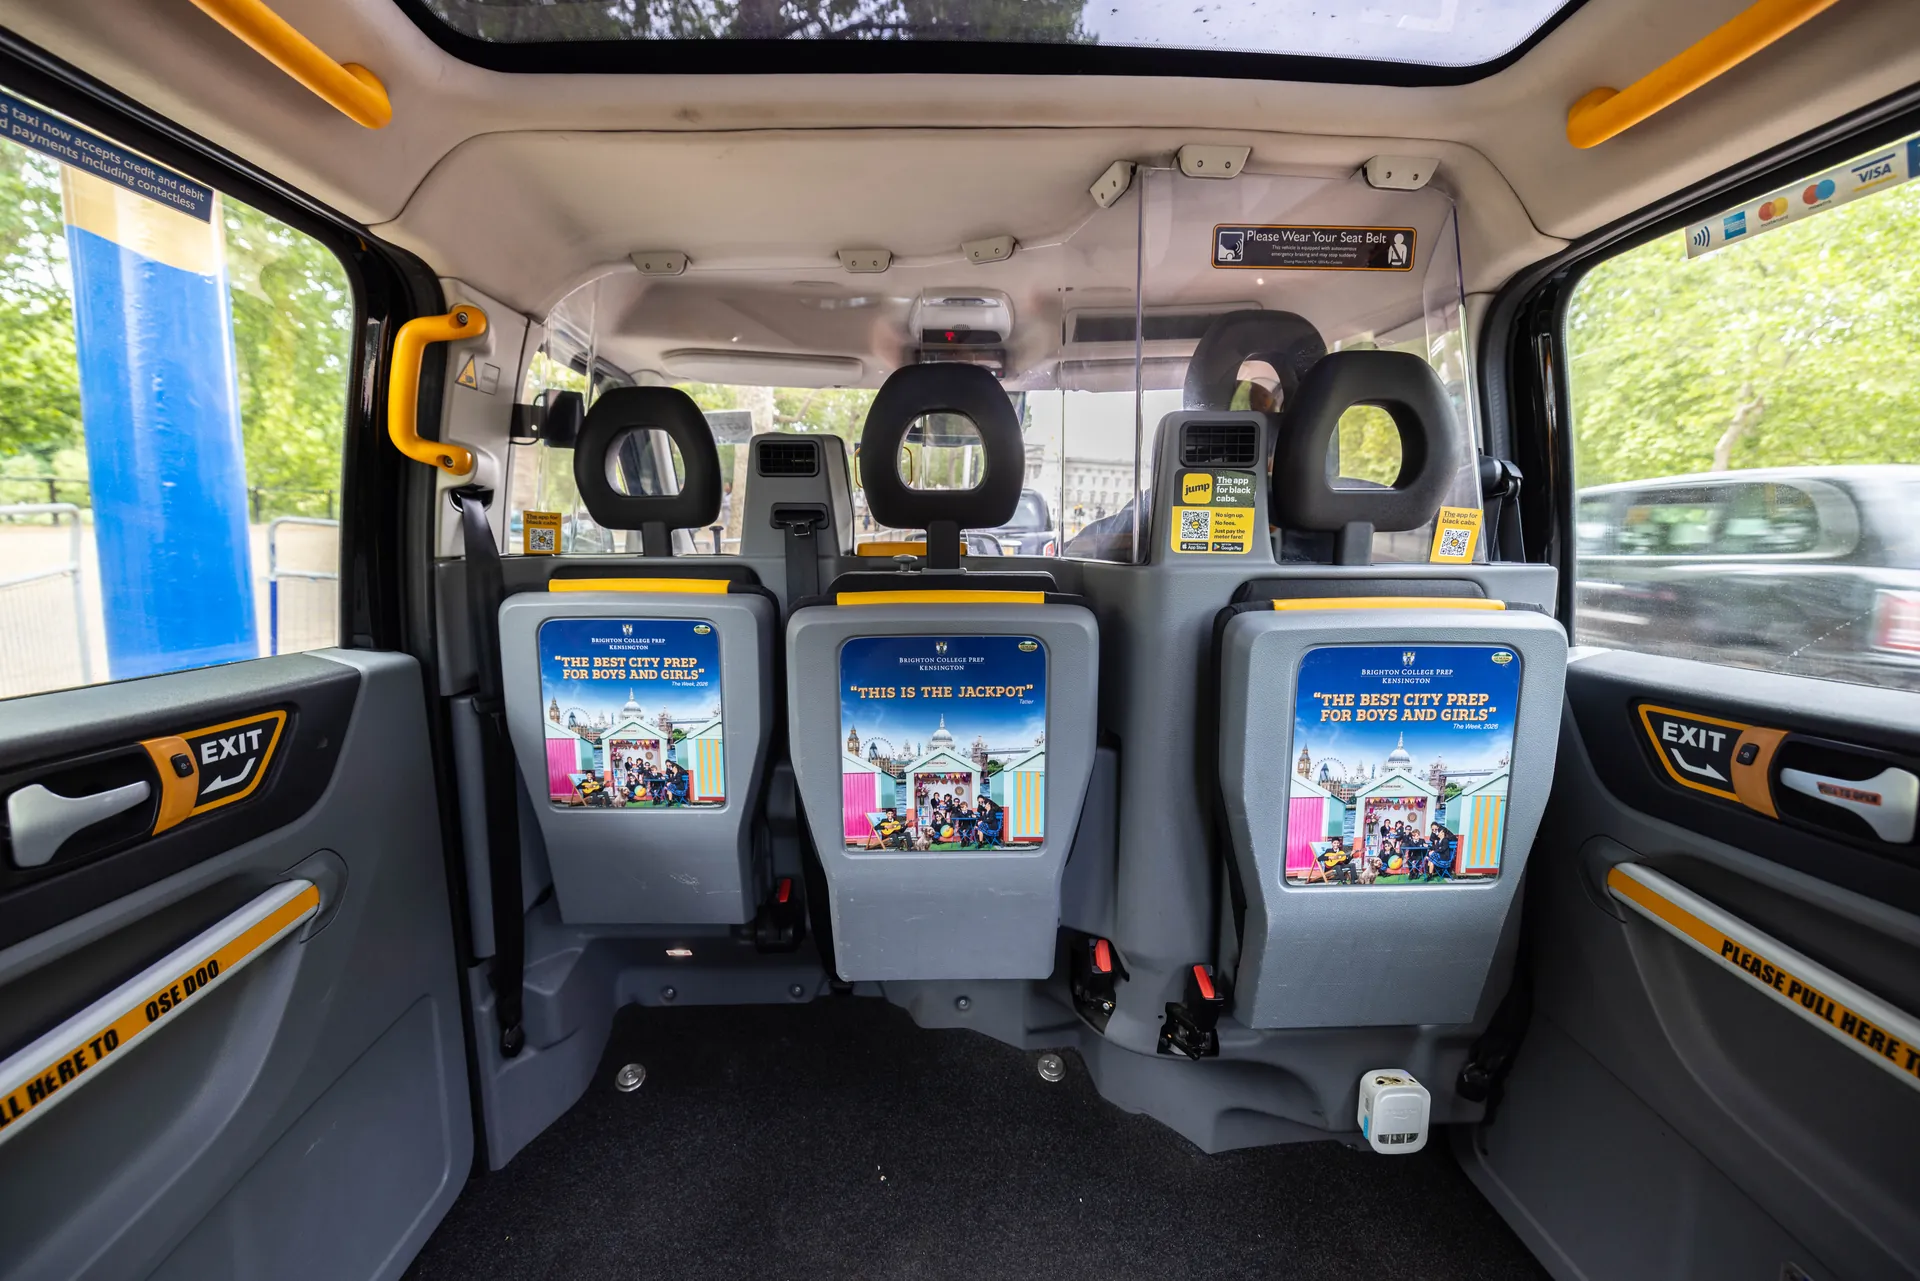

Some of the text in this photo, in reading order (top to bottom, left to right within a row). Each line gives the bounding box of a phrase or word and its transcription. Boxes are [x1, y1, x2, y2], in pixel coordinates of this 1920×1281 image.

[12, 107, 39, 127] taxi
[43, 123, 71, 141] now
[75, 138, 120, 164] accepts
[124, 159, 156, 180] credit
[158, 174, 177, 190] and
[180, 184, 204, 202] debit
[12, 125, 78, 160] payments
[82, 153, 135, 186] including
[138, 179, 196, 210] contactless
[1858, 163, 1892, 183] VISA
[1246, 230, 1386, 244] Please Wear Your Seat Belt
[1185, 483, 1210, 495] jump
[594, 657, 626, 667] BEST
[629, 657, 660, 667] CITY
[664, 658, 697, 668] PREP
[563, 670, 589, 679] FOR
[592, 670, 626, 680] BOYS
[629, 670, 657, 680] AND
[901, 687, 916, 698] IS
[921, 687, 952, 698] THE
[1360, 694, 1400, 706] BEST
[1404, 694, 1443, 706] CITY
[1446, 694, 1489, 706] PREP
[1320, 710, 1352, 722] FOR
[1356, 710, 1398, 722] BOYS
[1401, 710, 1437, 721] AND
[1662, 721, 1726, 752] EXIT
[201, 728, 262, 764] EXIT
[1721, 940, 1920, 1080] PLEASE PULL HERE T
[26, 1048, 88, 1106] HERE
[90, 1028, 118, 1061] TO
